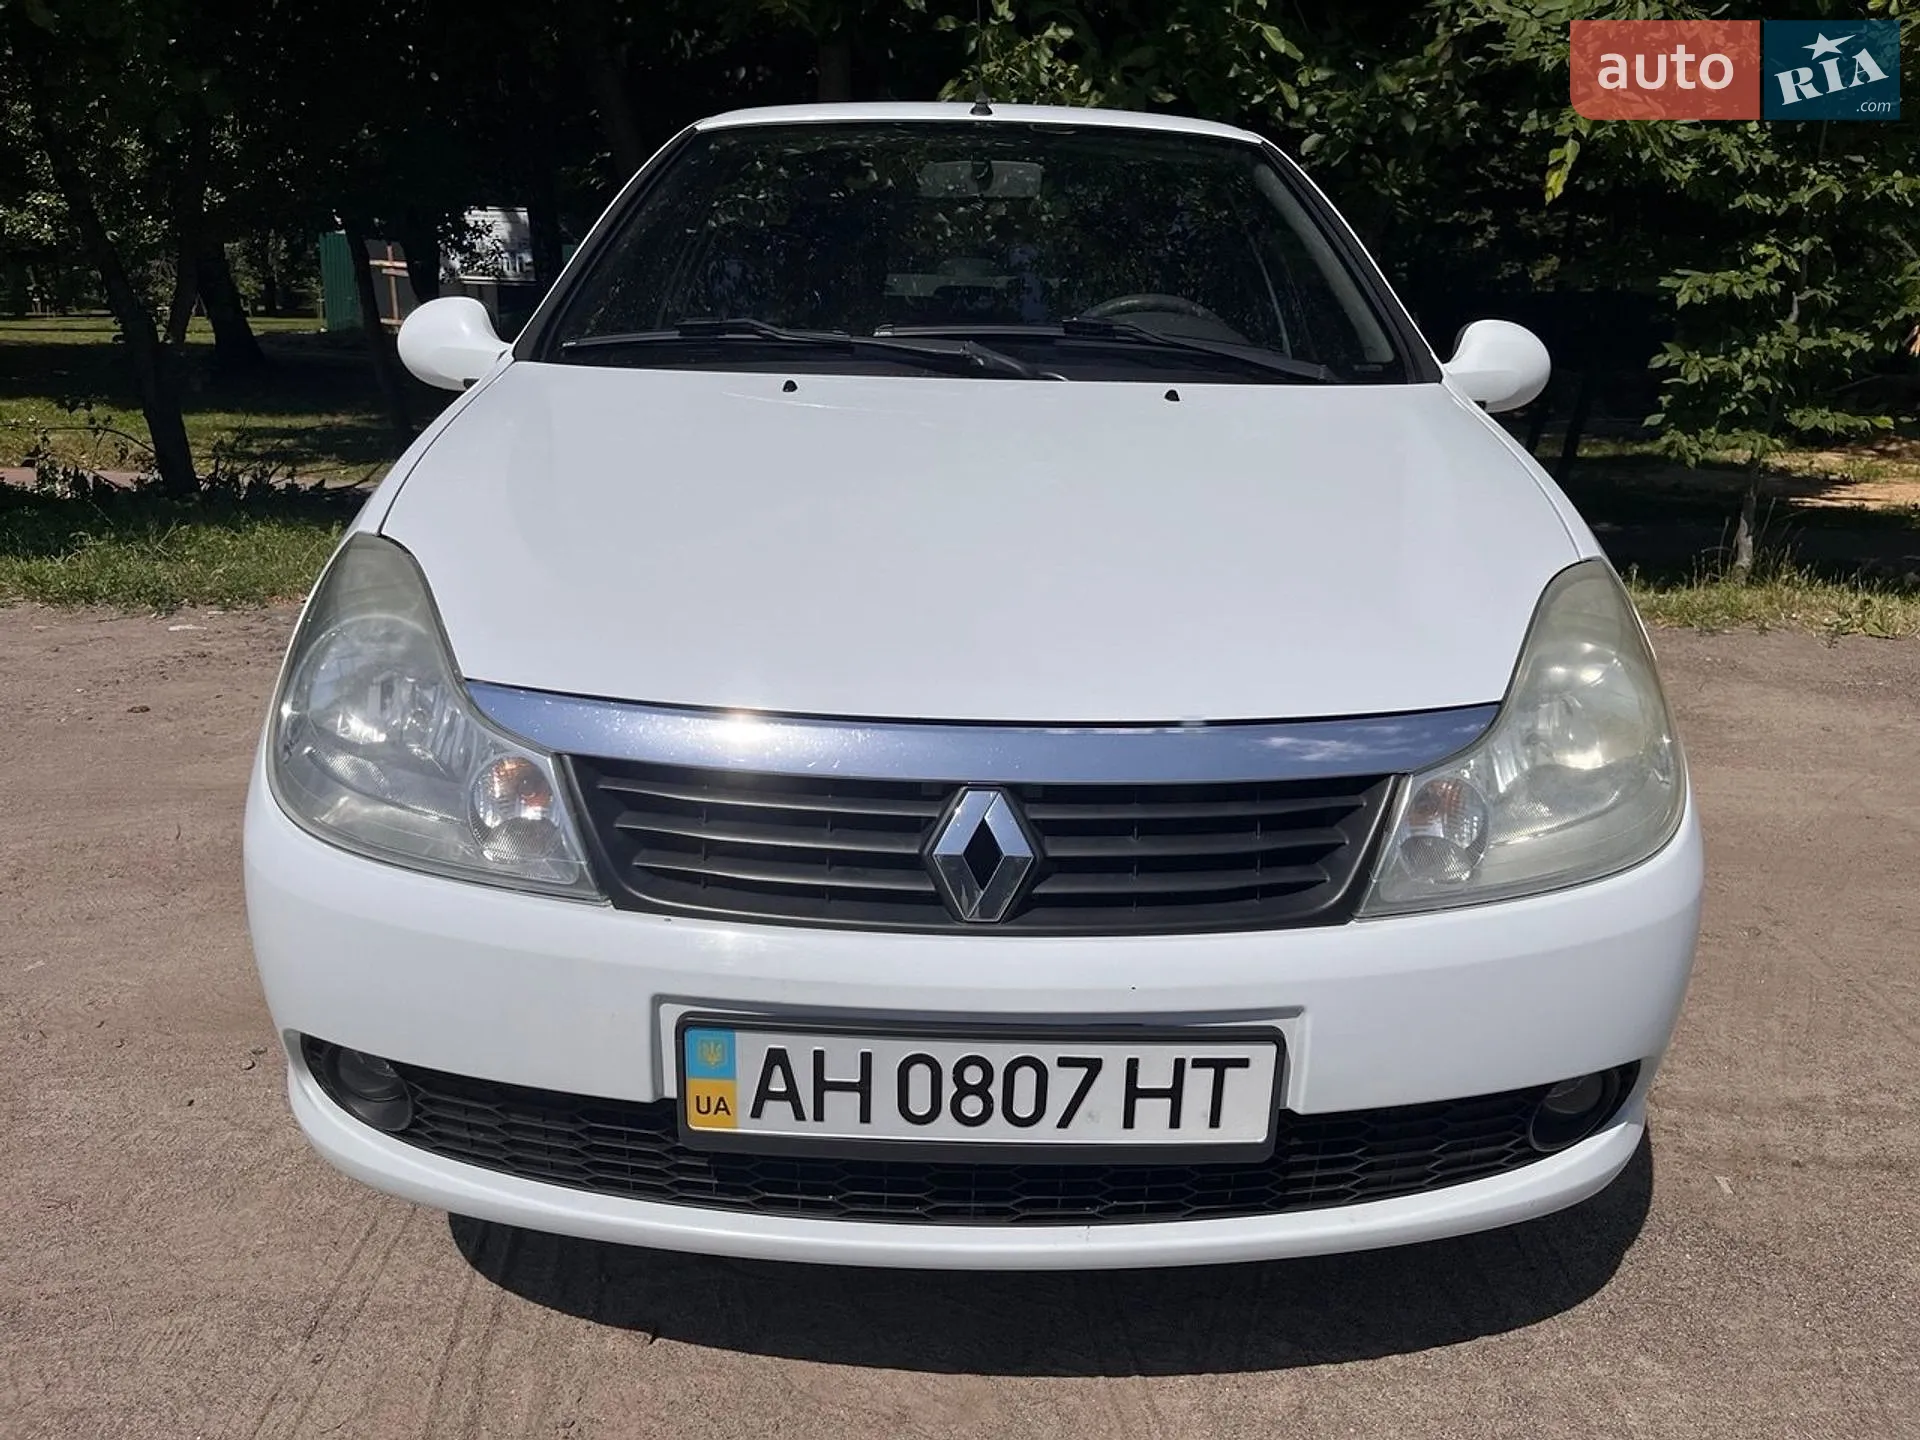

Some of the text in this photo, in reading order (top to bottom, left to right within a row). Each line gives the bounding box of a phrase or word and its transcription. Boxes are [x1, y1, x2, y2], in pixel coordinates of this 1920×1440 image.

[695, 1095, 731, 1117] UA
[750, 1047, 1250, 1129] AH 0807 HT
